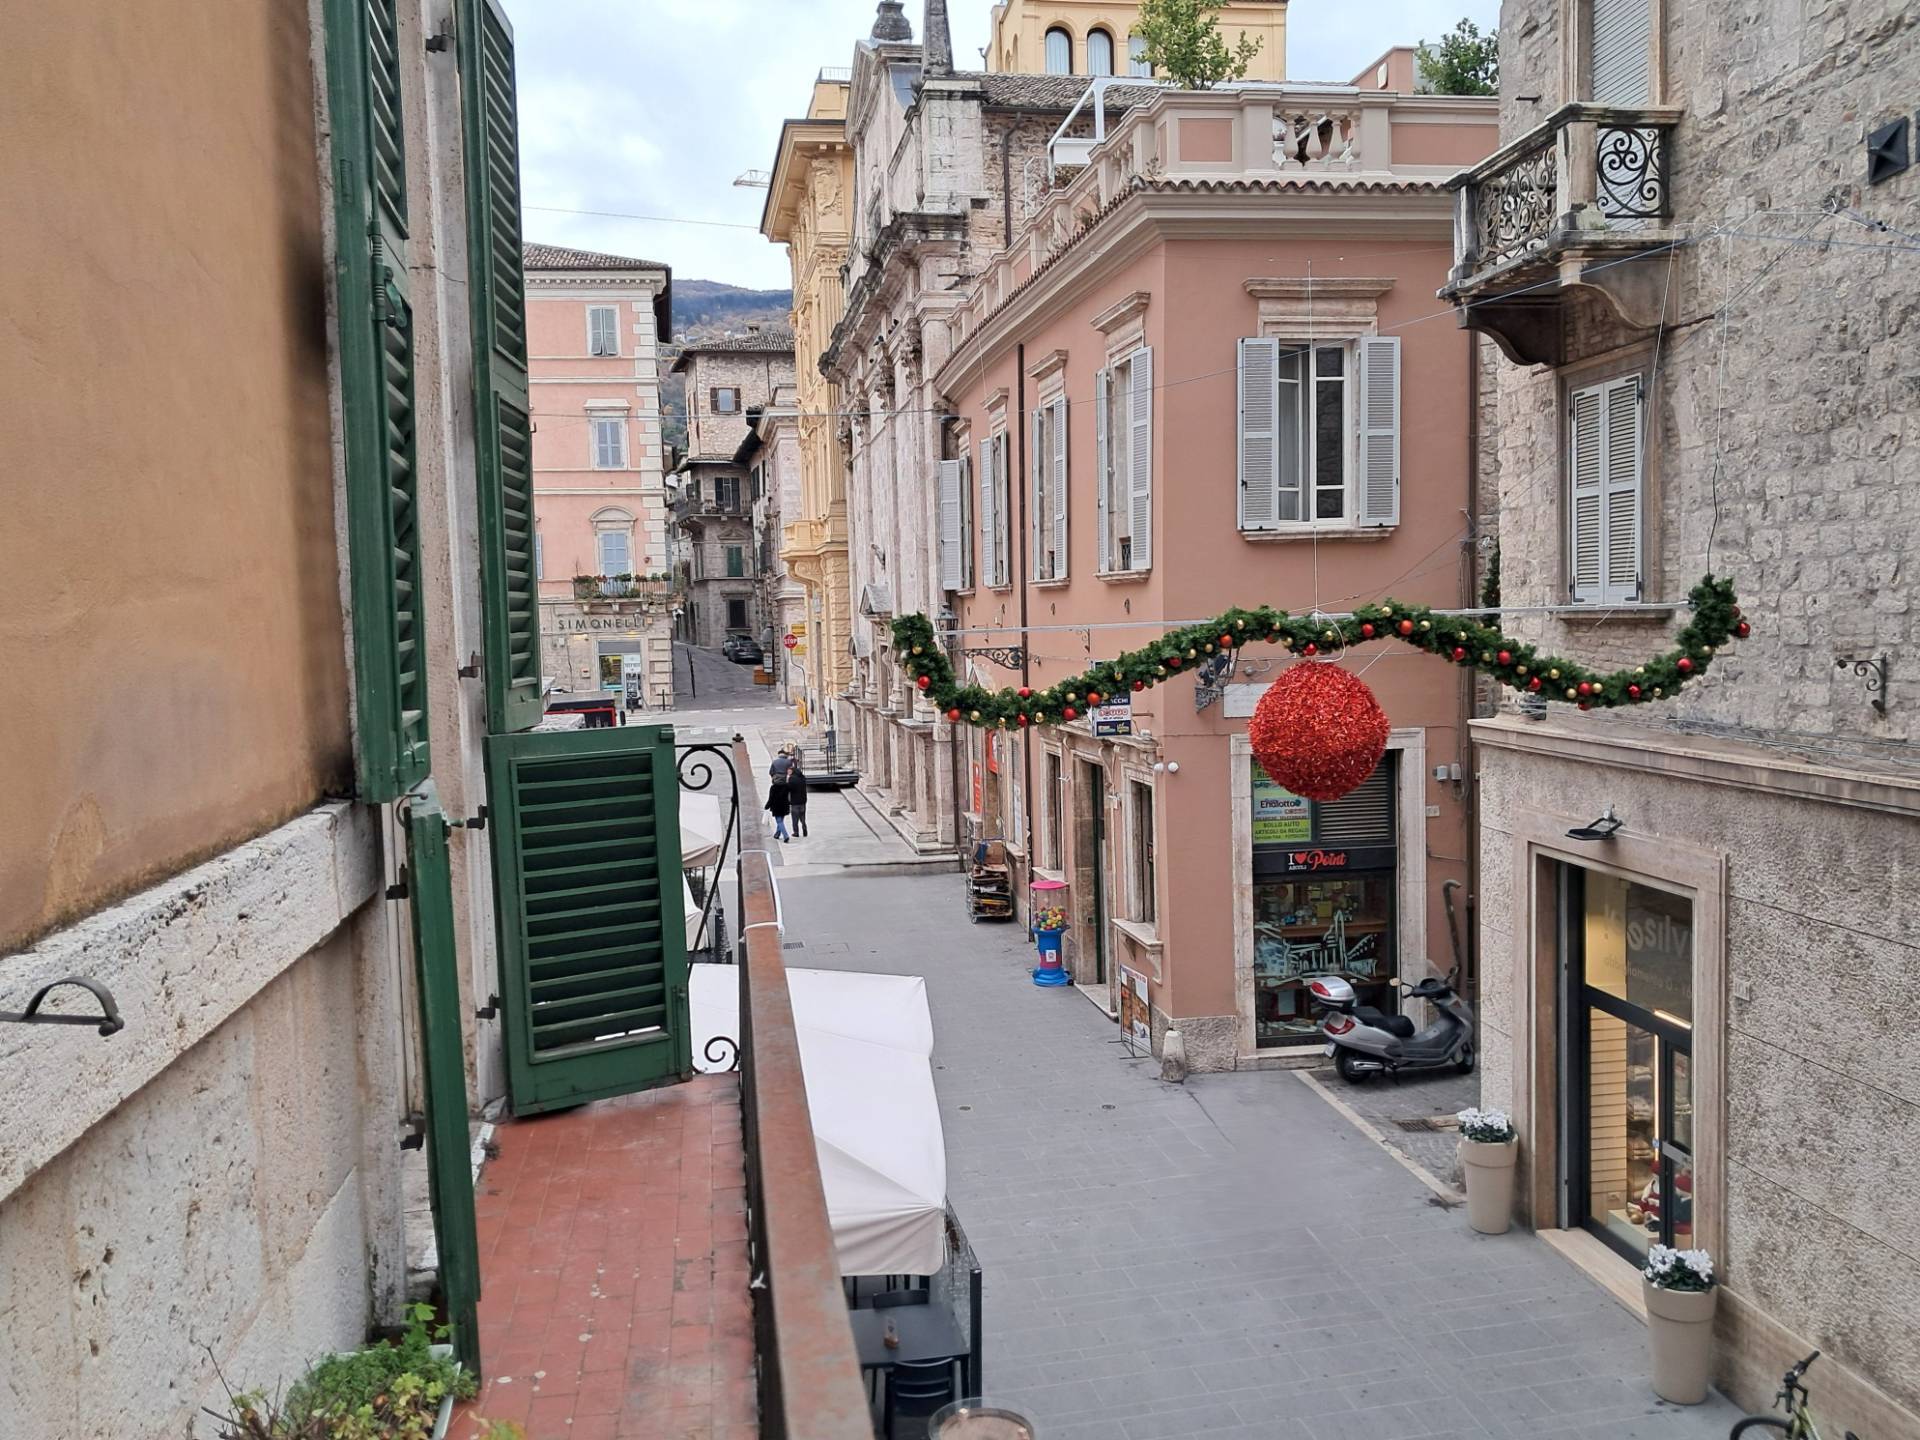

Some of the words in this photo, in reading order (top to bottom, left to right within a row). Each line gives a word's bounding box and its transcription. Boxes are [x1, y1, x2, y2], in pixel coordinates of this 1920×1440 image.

[558, 618, 646, 630] SIMONELLI
[784, 637, 797, 645] STOP
[1288, 853, 1295, 865] I
[1307, 850, 1345, 870] Point
